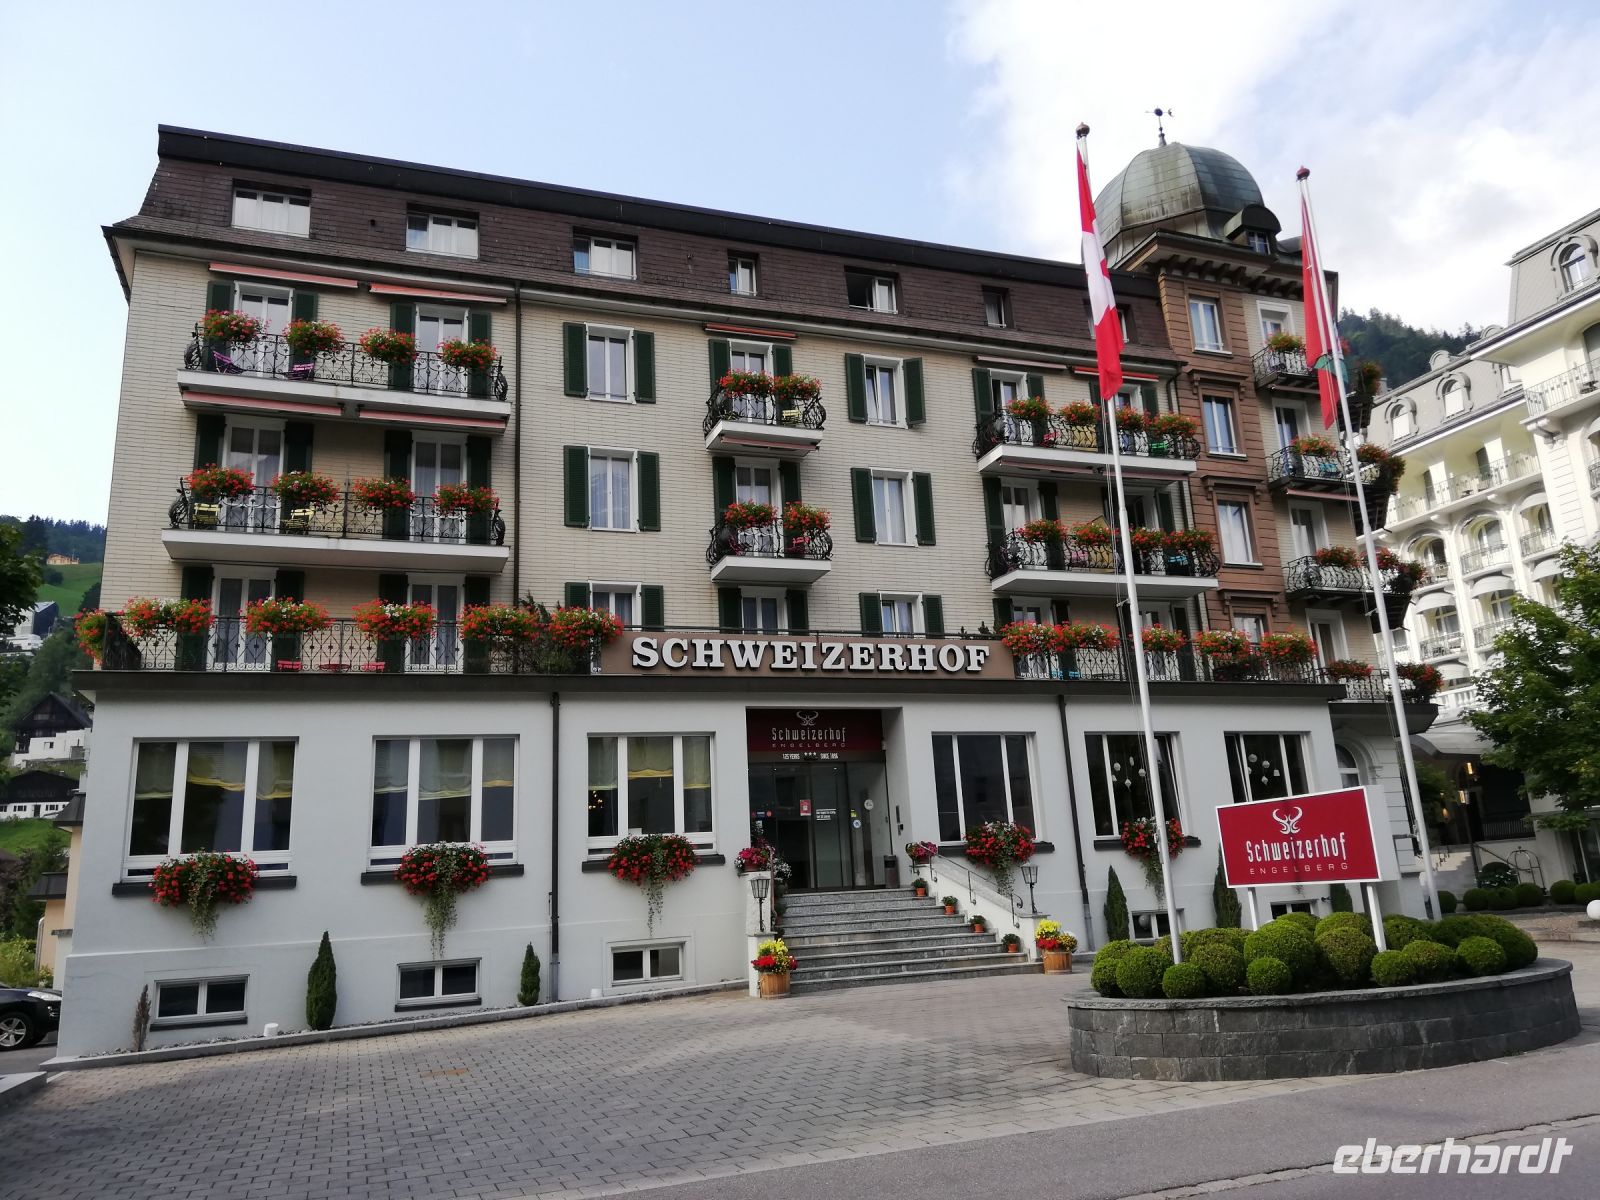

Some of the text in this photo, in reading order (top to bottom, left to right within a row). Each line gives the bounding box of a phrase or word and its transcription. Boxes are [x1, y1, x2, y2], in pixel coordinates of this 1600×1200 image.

[632, 636, 990, 673] SCHWEIZERHOF
[771, 727, 846, 742] Schweizerhof
[1245, 832, 1347, 863] Schweizerhof
[1249, 862, 1348, 875] ENGELBERG
